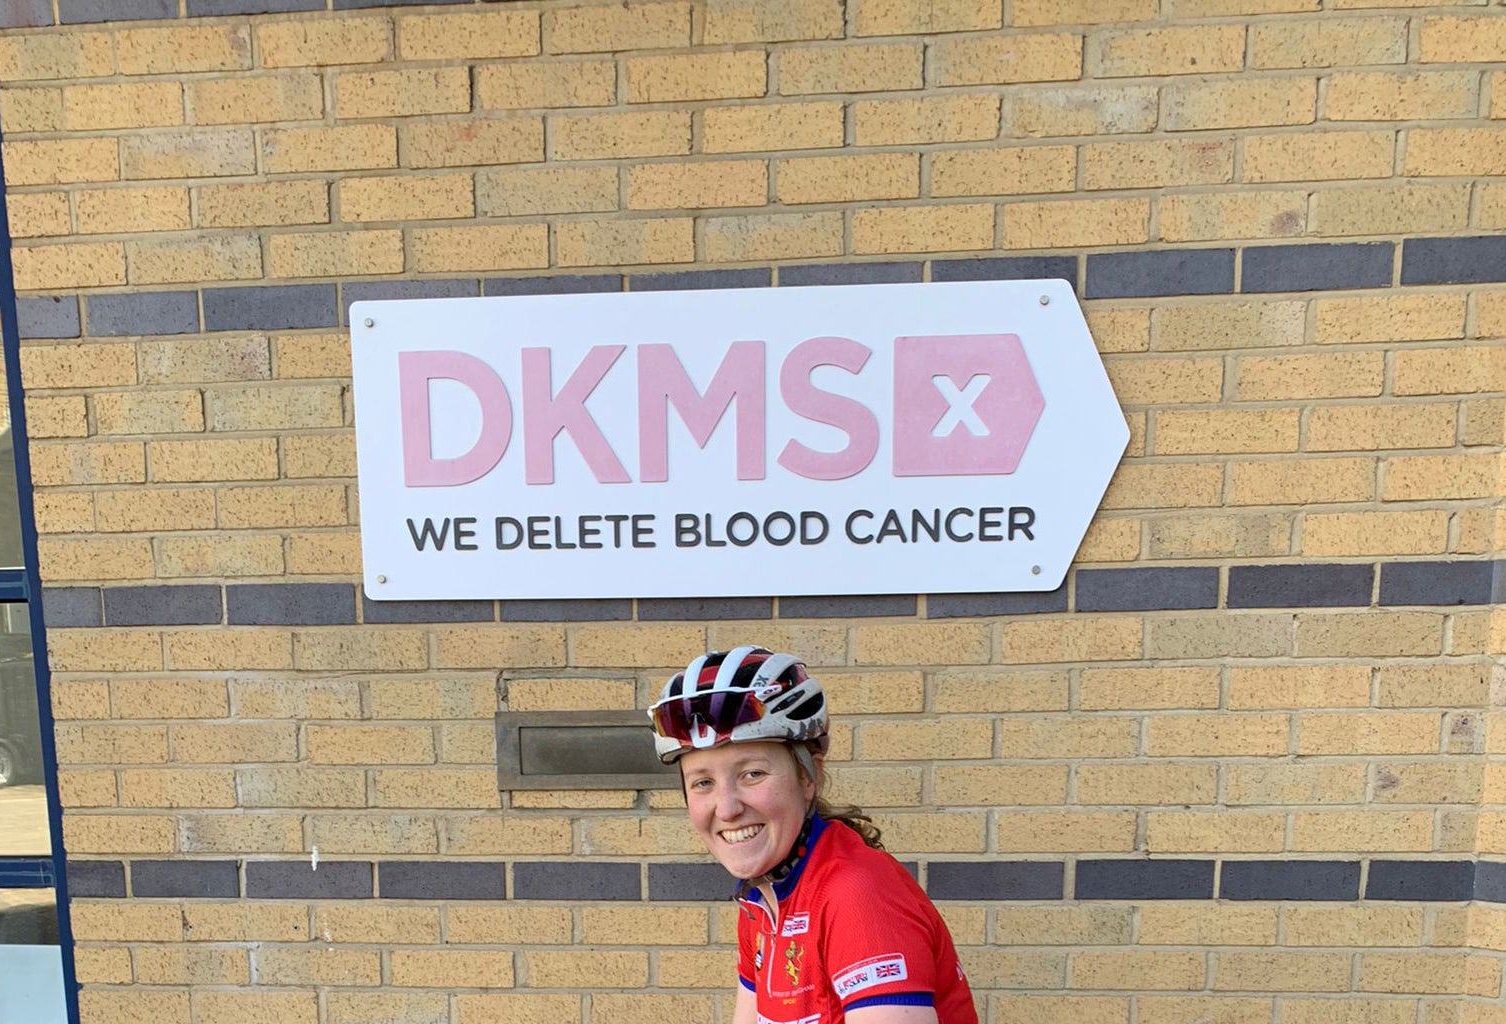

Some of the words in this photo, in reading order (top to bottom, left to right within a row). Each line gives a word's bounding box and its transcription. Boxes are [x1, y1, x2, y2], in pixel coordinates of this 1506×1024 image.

[399, 335, 880, 488] DKMS
[406, 516, 478, 552] WE
[495, 513, 656, 550] DELETE
[675, 509, 831, 547] BLOOD
[845, 506, 1036, 545] CANCER
